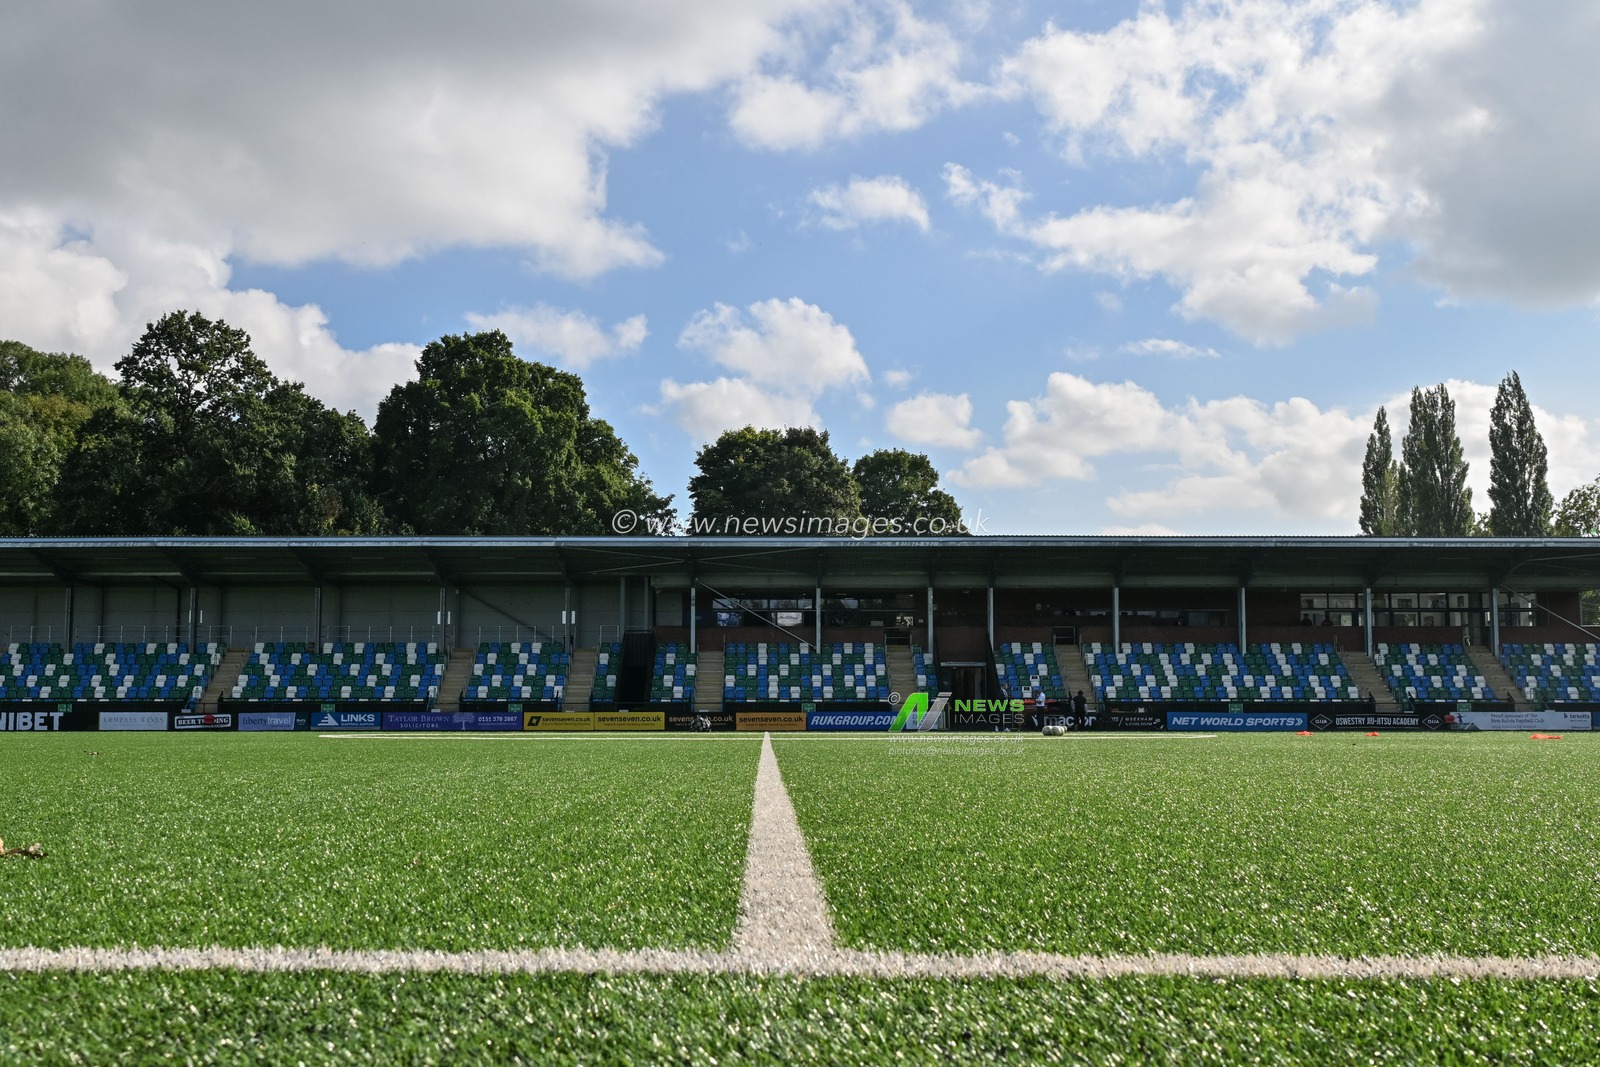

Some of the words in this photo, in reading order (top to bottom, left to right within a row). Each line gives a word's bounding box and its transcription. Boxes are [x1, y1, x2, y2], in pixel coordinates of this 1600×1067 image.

[178, 718, 197, 726] BEER
[340, 714, 375, 722] LINKS
[387, 714, 418, 722] TAYLOR
[421, 714, 450, 722] BROWN
[739, 715, 803, 723] sevenseven.co.uk
[1172, 717, 1199, 725] NET
[1200, 717, 1244, 726] WORLD
[1246, 717, 1295, 726] SPORTS
[1335, 717, 1365, 726] OSWESTRY
[1366, 717, 1392, 725] JIU-JITSU
[1392, 717, 1419, 725] ACADEMY
